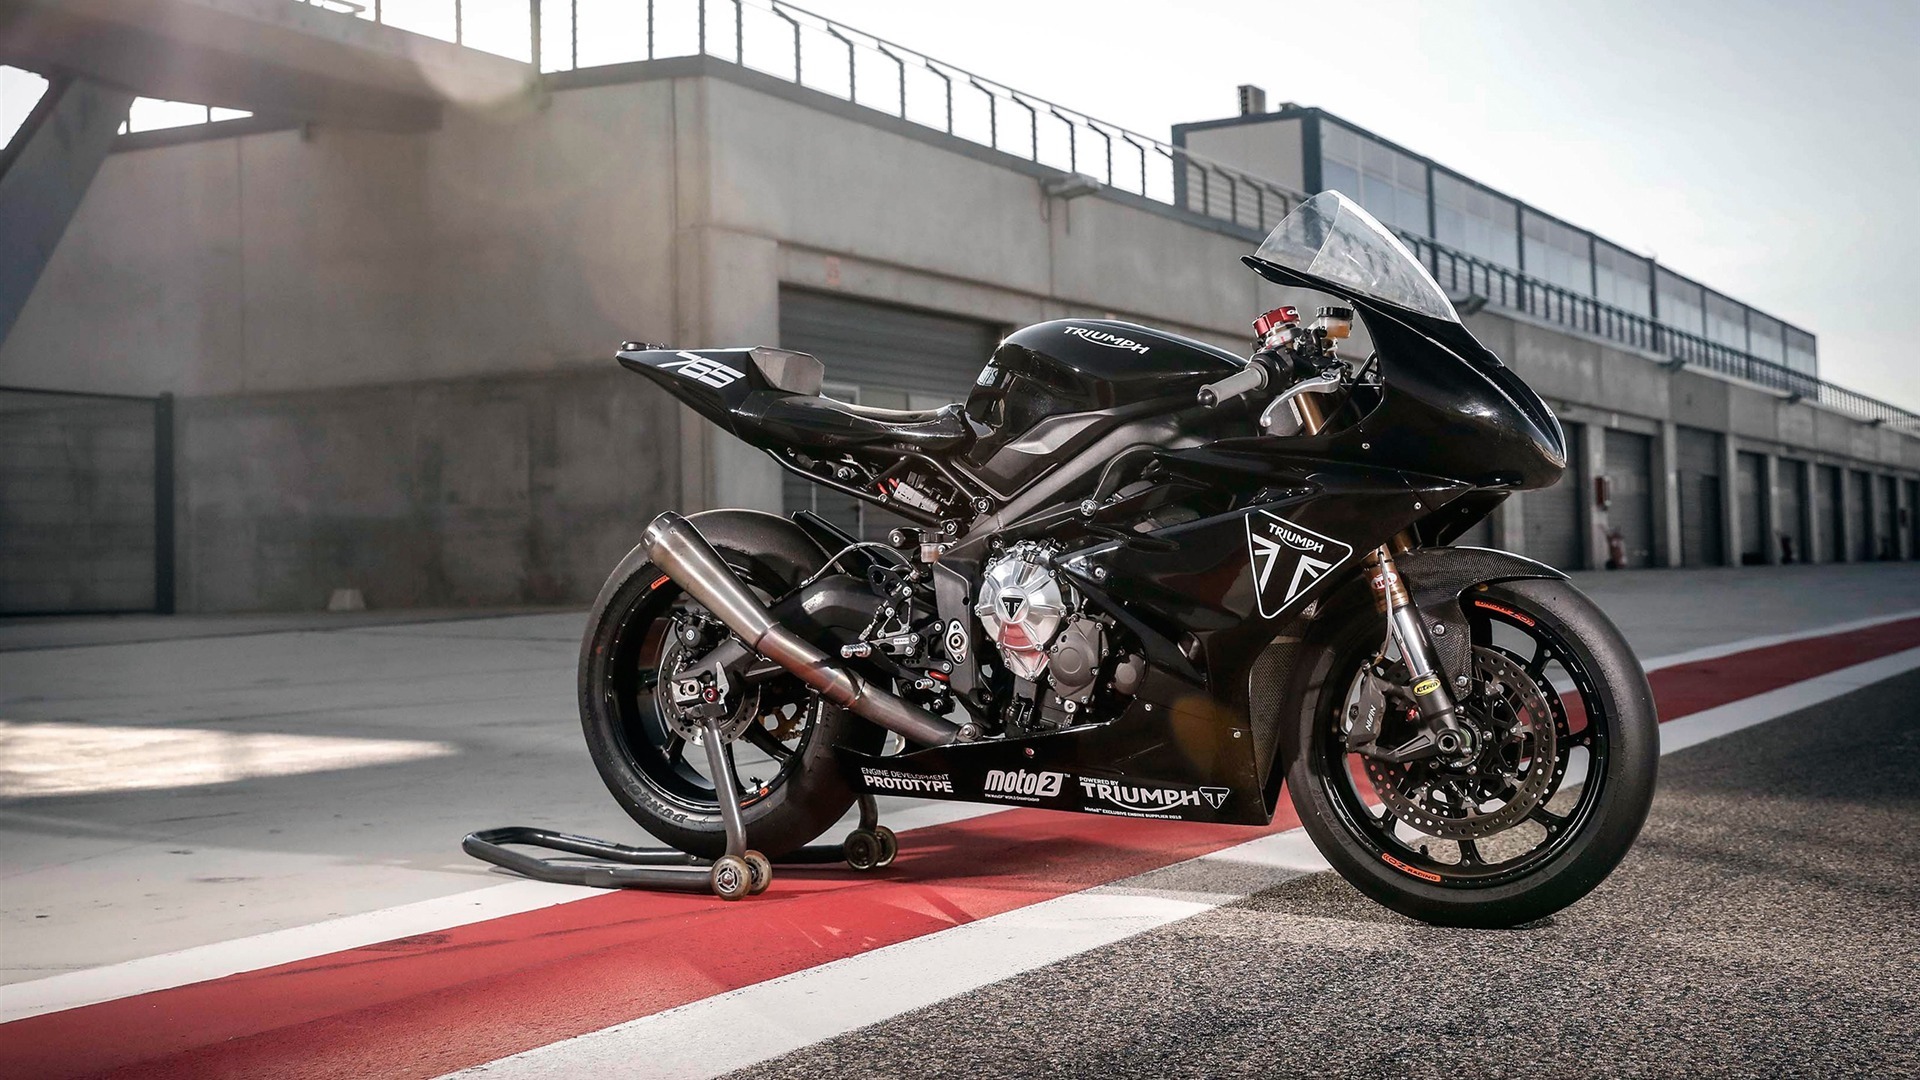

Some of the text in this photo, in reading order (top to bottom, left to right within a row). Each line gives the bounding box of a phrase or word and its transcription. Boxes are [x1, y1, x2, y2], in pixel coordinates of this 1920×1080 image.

[1064, 326, 1150, 354] TRIUMPH
[656, 351, 746, 389] 765
[1269, 522, 1324, 554] TRIUMPH
[861, 767, 950, 781] ENGINE DEVELOPMENT
[863, 775, 954, 793] PROTOTYPE
[1079, 776, 1110, 785] POWERED
[1079, 782, 1201, 811] TRIUMPH
